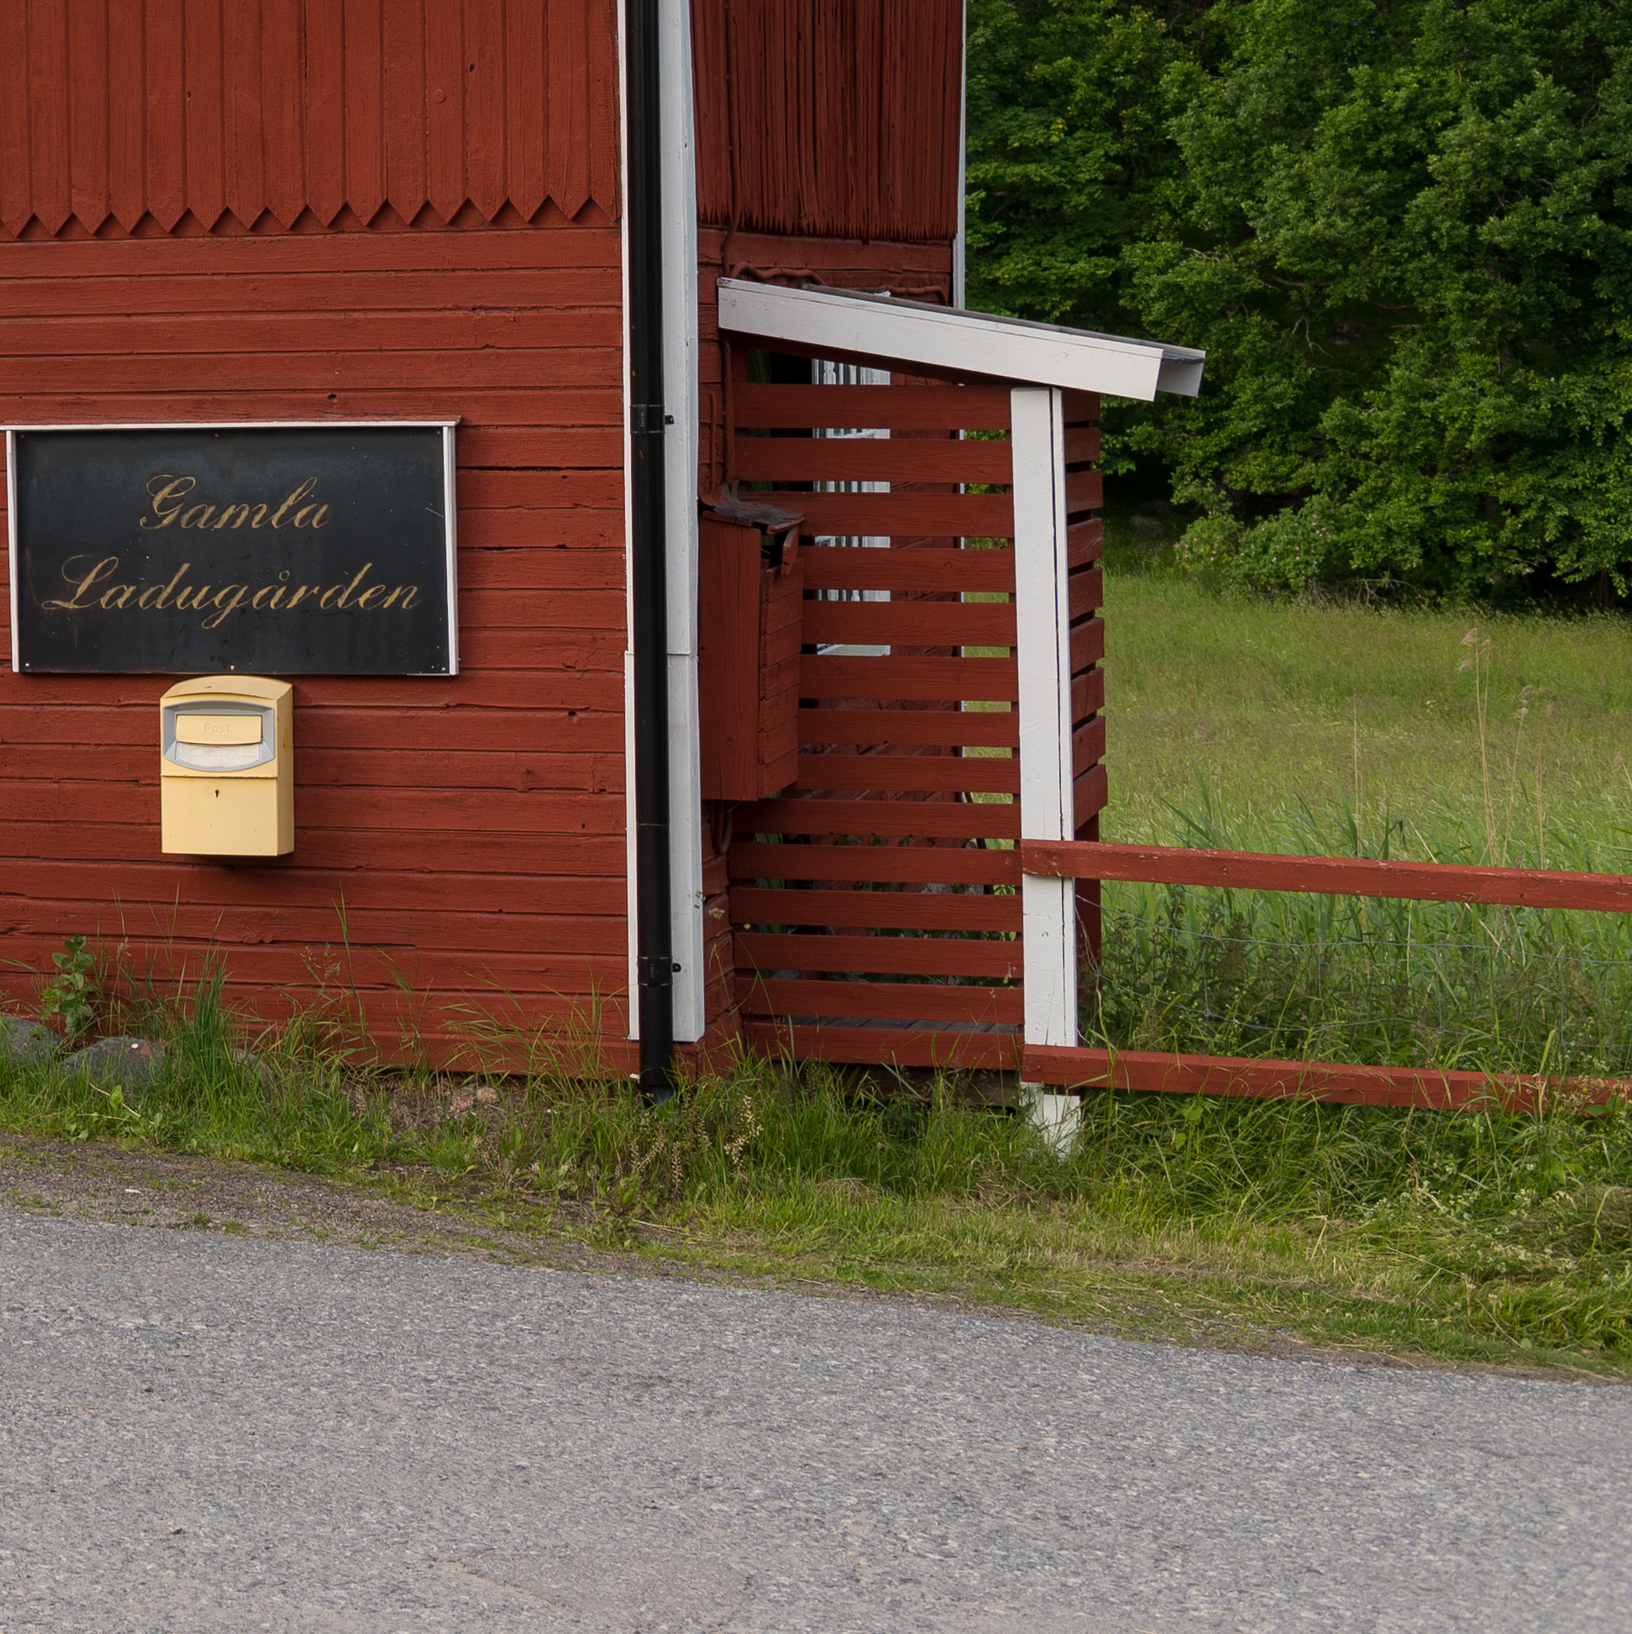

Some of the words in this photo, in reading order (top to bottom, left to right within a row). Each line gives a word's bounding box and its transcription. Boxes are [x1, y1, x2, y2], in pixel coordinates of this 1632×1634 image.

[139, 473, 331, 531] Gamla
[42, 554, 421, 630] Ladugården
[203, 722, 233, 735] Post
